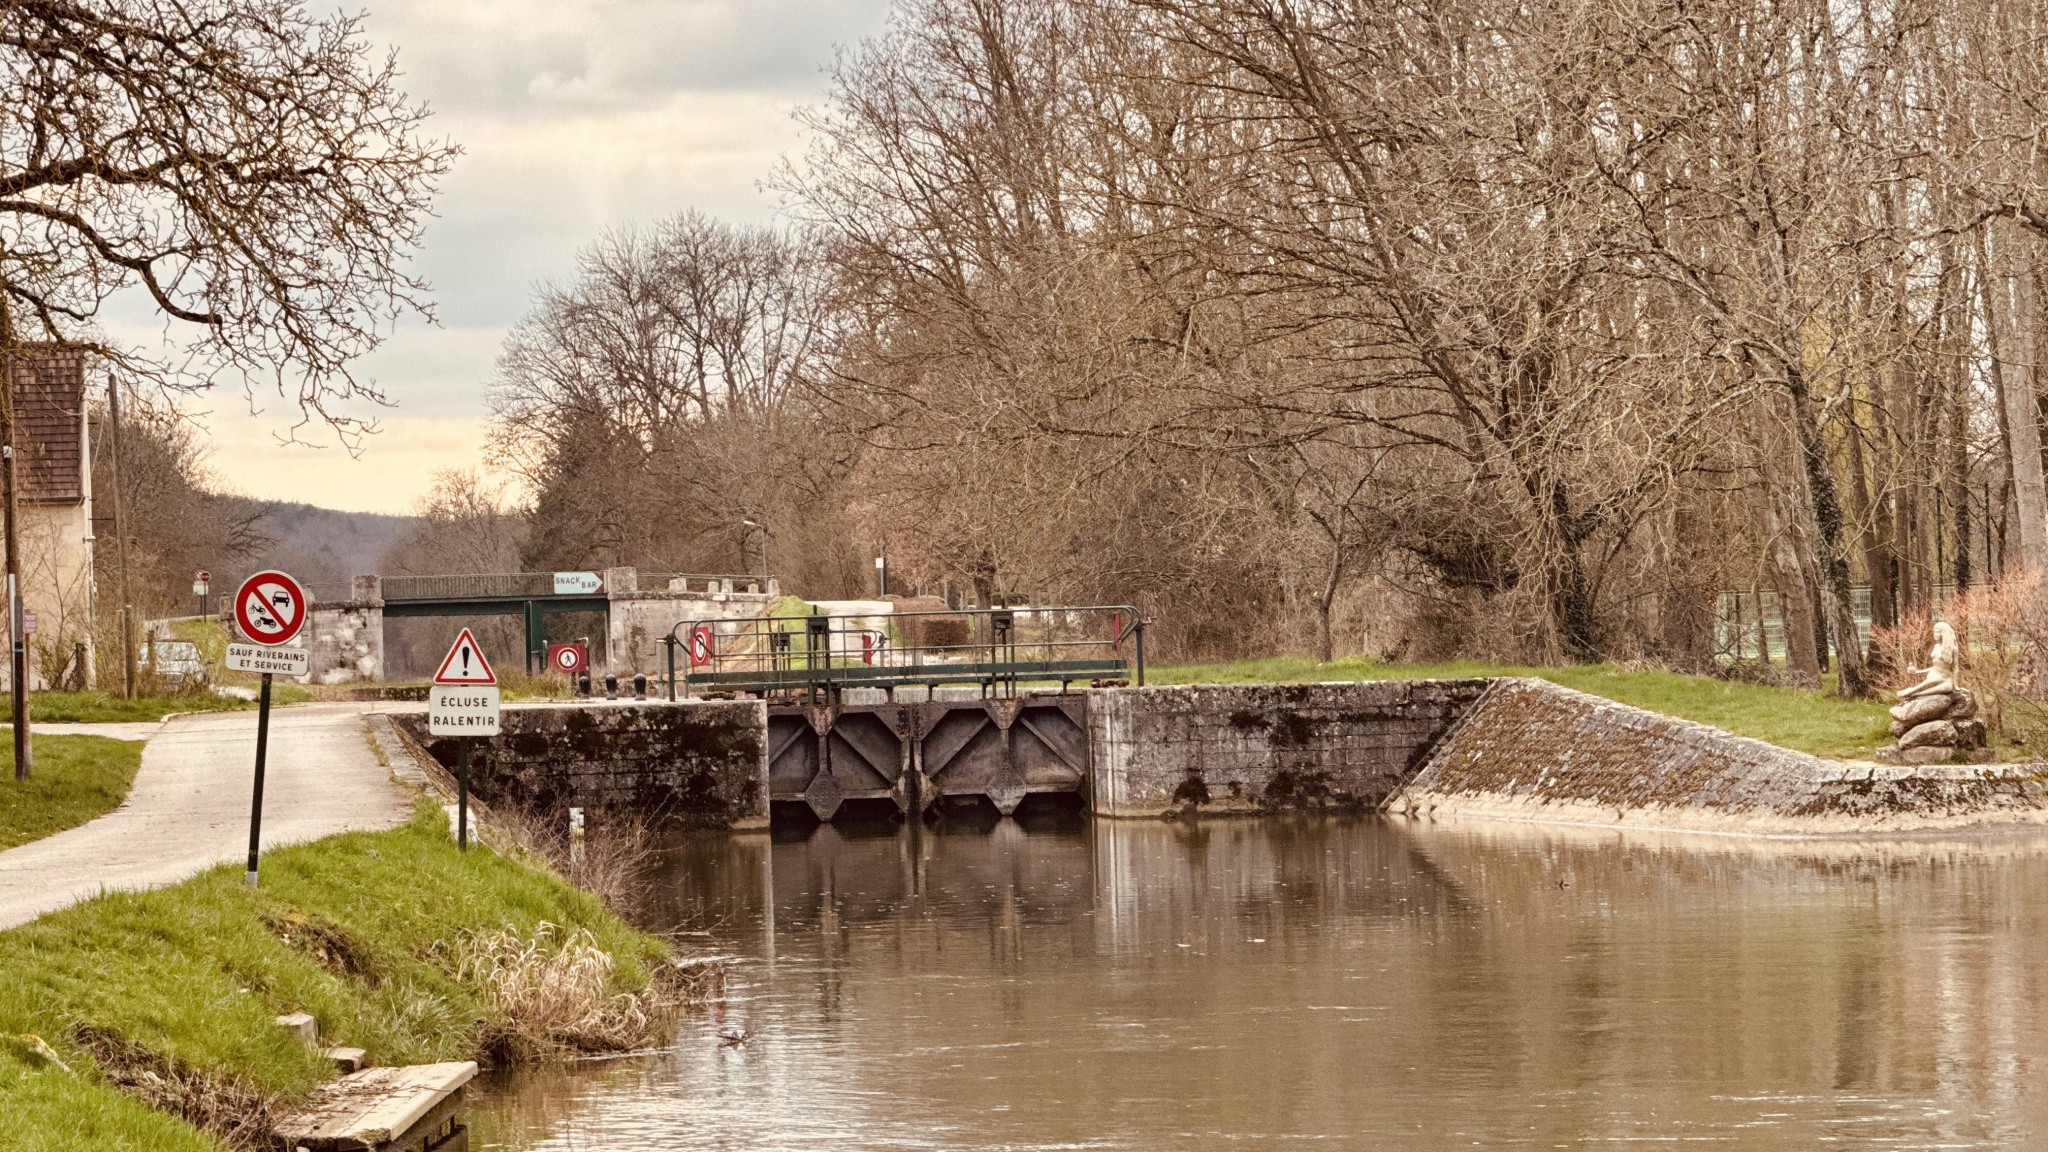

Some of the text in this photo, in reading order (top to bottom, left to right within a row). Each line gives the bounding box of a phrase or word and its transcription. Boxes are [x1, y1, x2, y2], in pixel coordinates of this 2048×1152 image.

[555, 576, 580, 584] SNACK
[229, 648, 305, 662] SAUF RIVERAINS
[254, 661, 293, 671] SERVICE
[441, 695, 488, 707] ÉCLUSE
[433, 716, 495, 726] RALENTIR
